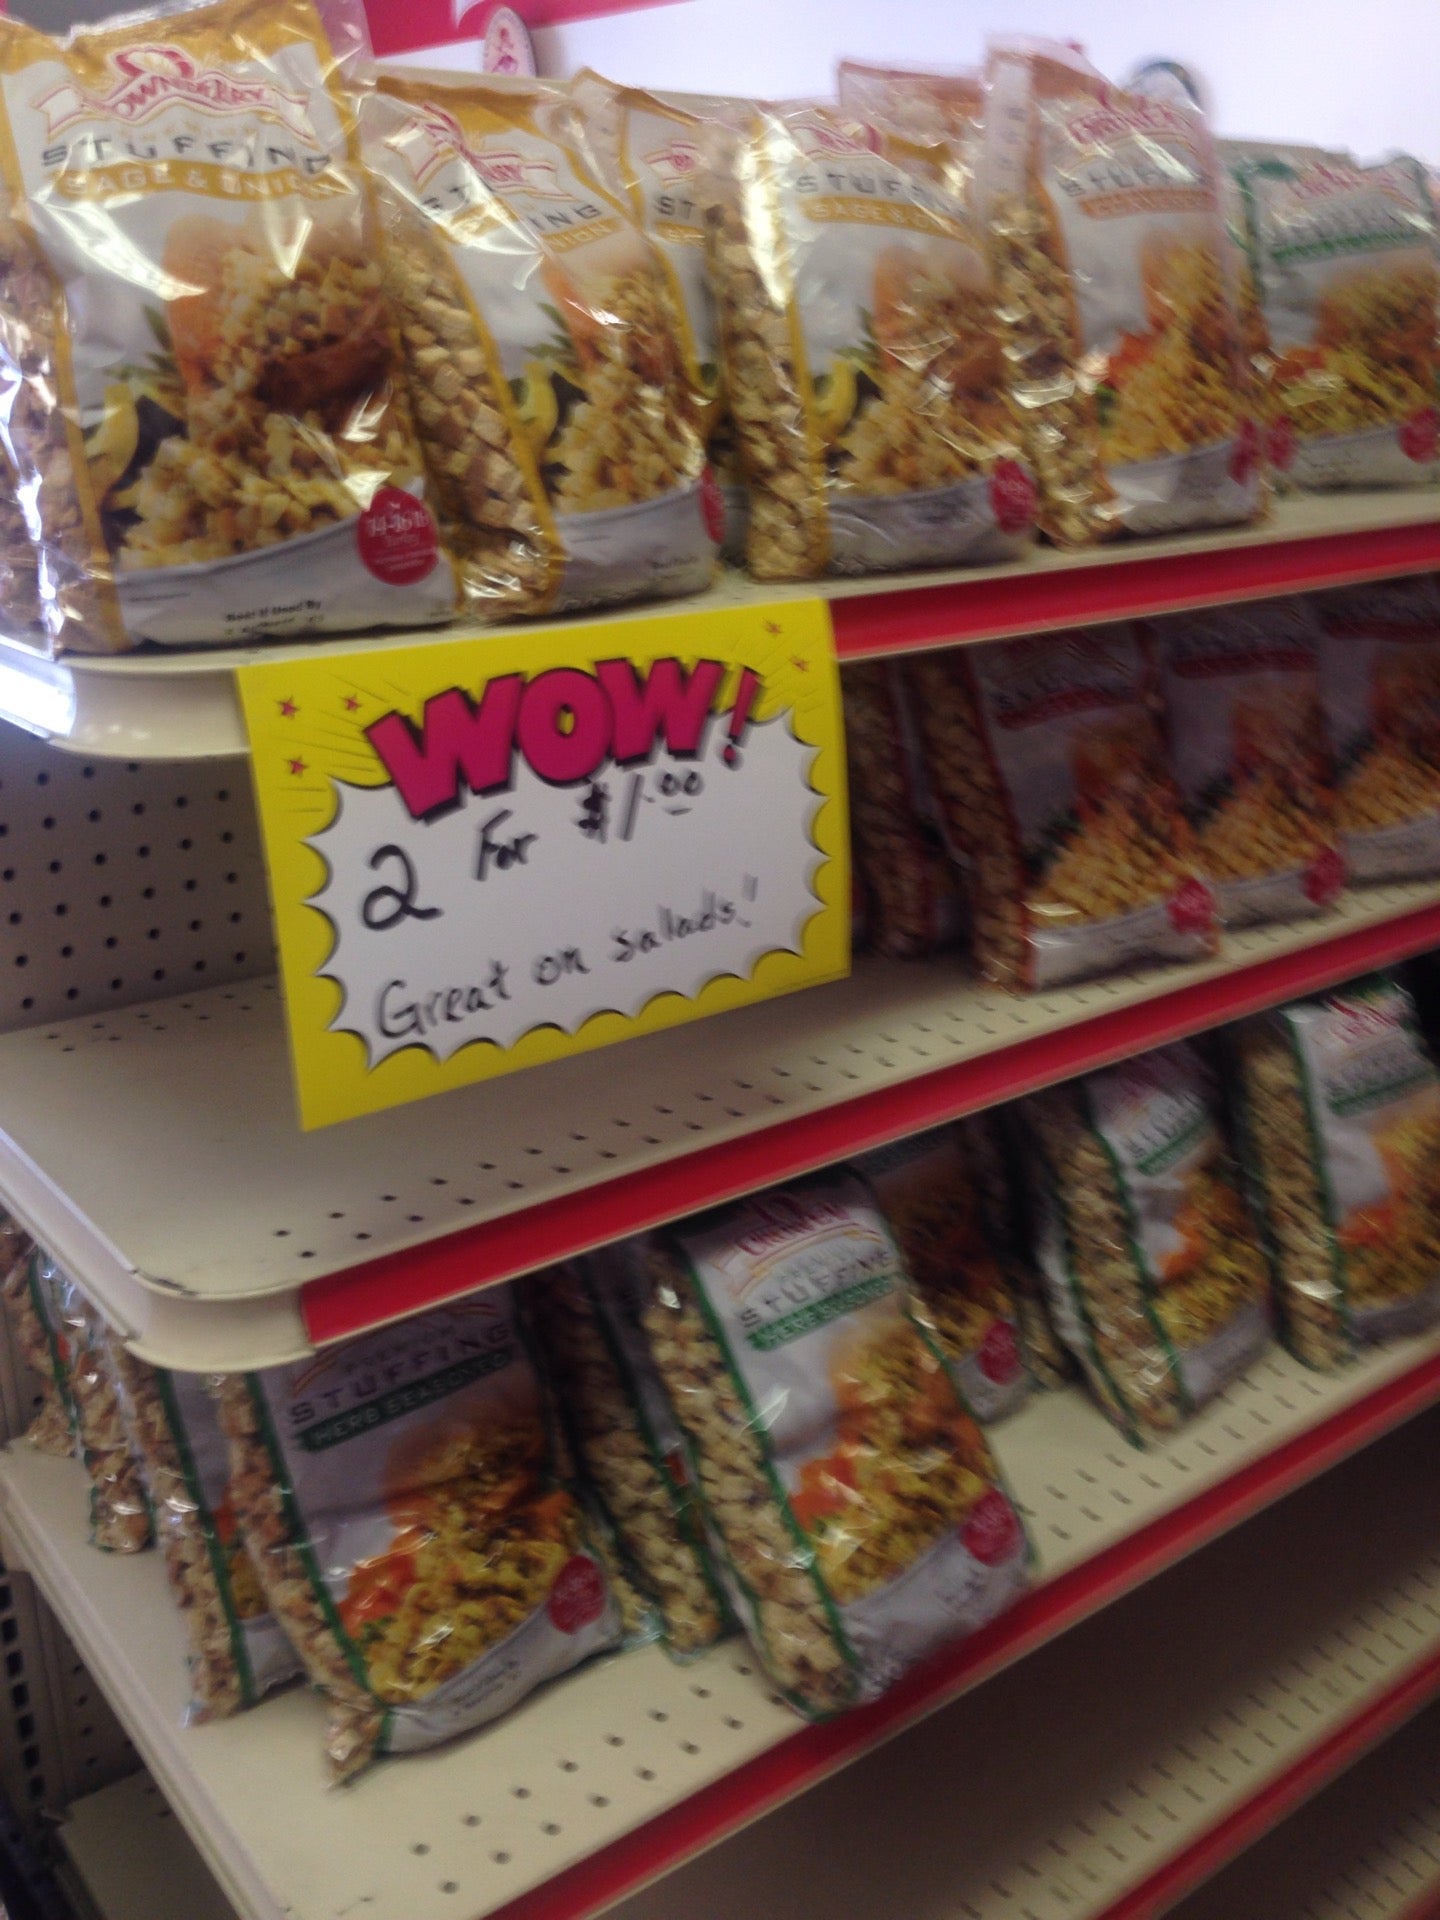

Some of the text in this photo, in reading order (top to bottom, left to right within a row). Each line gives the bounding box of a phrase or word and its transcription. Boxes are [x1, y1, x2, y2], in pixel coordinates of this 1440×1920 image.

[365, 656, 764, 824] WOW!
[361, 844, 443, 931] 2
[375, 957, 511, 1039] Great
[533, 945, 591, 987] on
[289, 1322, 512, 1425] STUFFING
